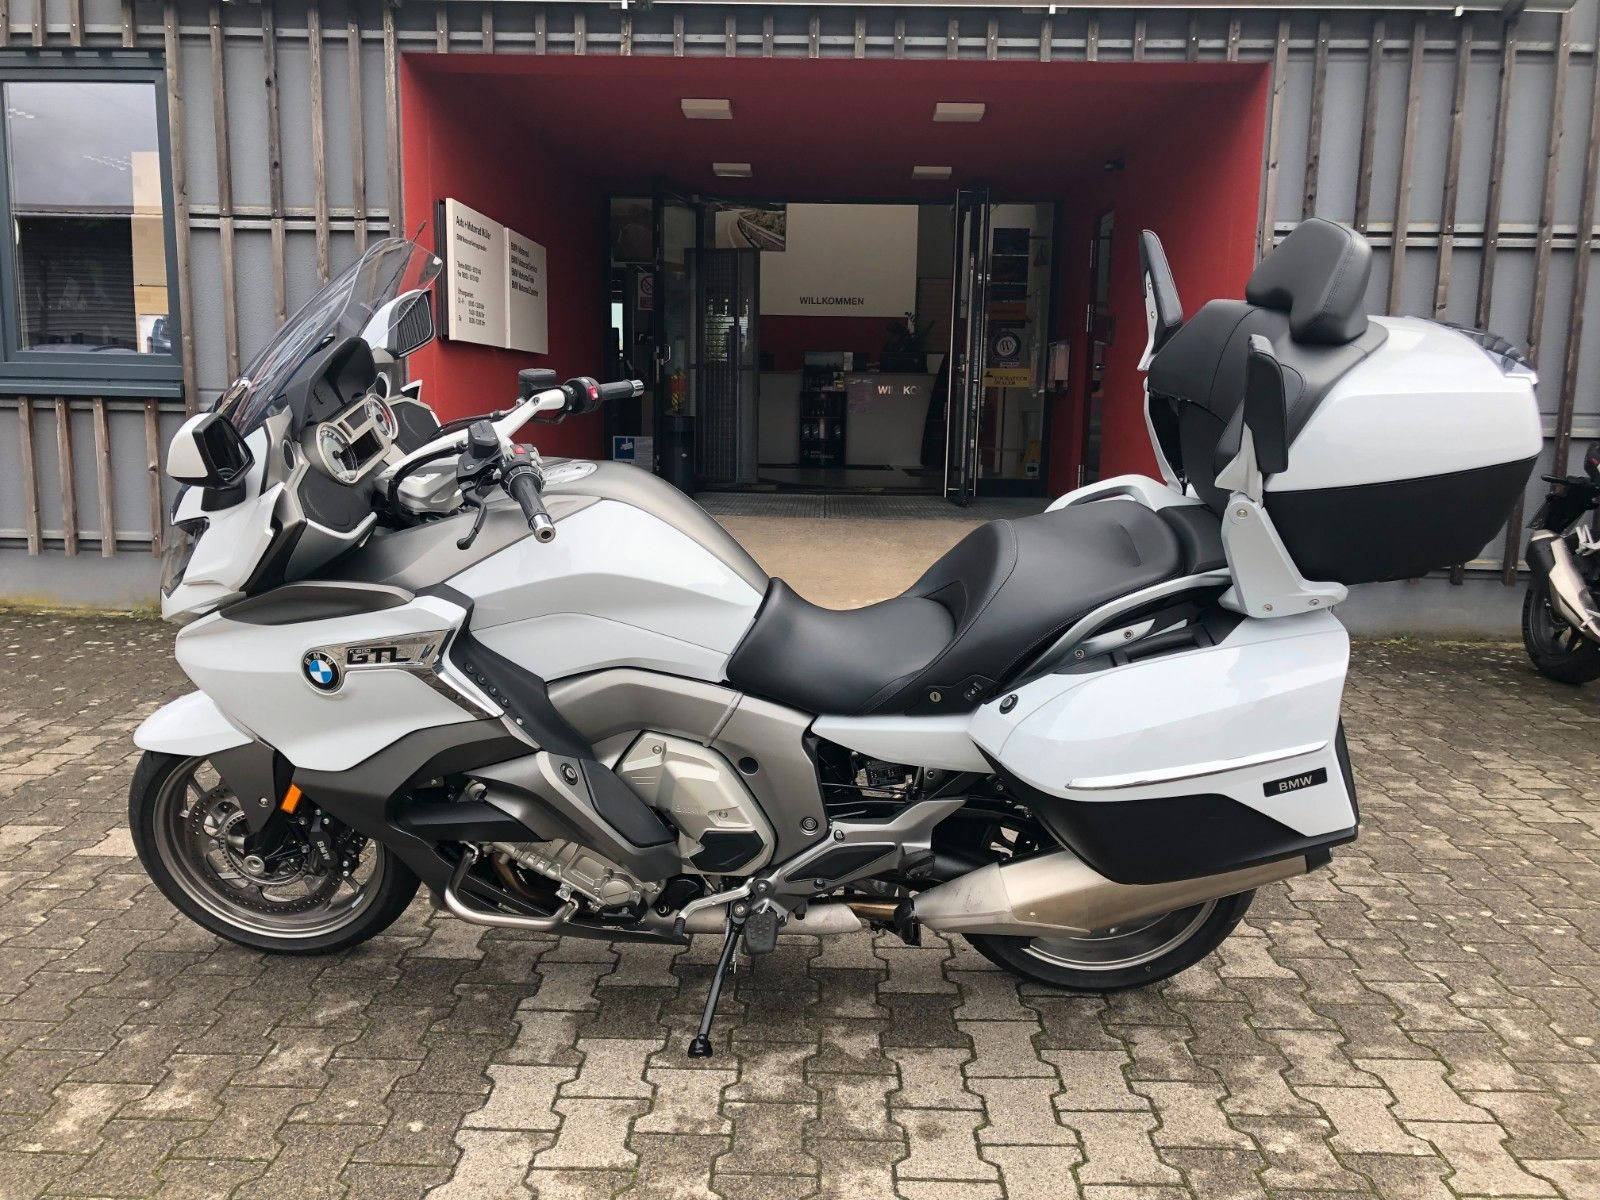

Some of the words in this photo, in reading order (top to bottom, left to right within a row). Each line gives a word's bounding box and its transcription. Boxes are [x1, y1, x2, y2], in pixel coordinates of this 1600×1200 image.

[799, 296, 865, 306] WILLKOMMEN
[347, 646, 412, 665] GTL
[1278, 774, 1313, 792] BMW
[316, 840, 331, 860] BMW
